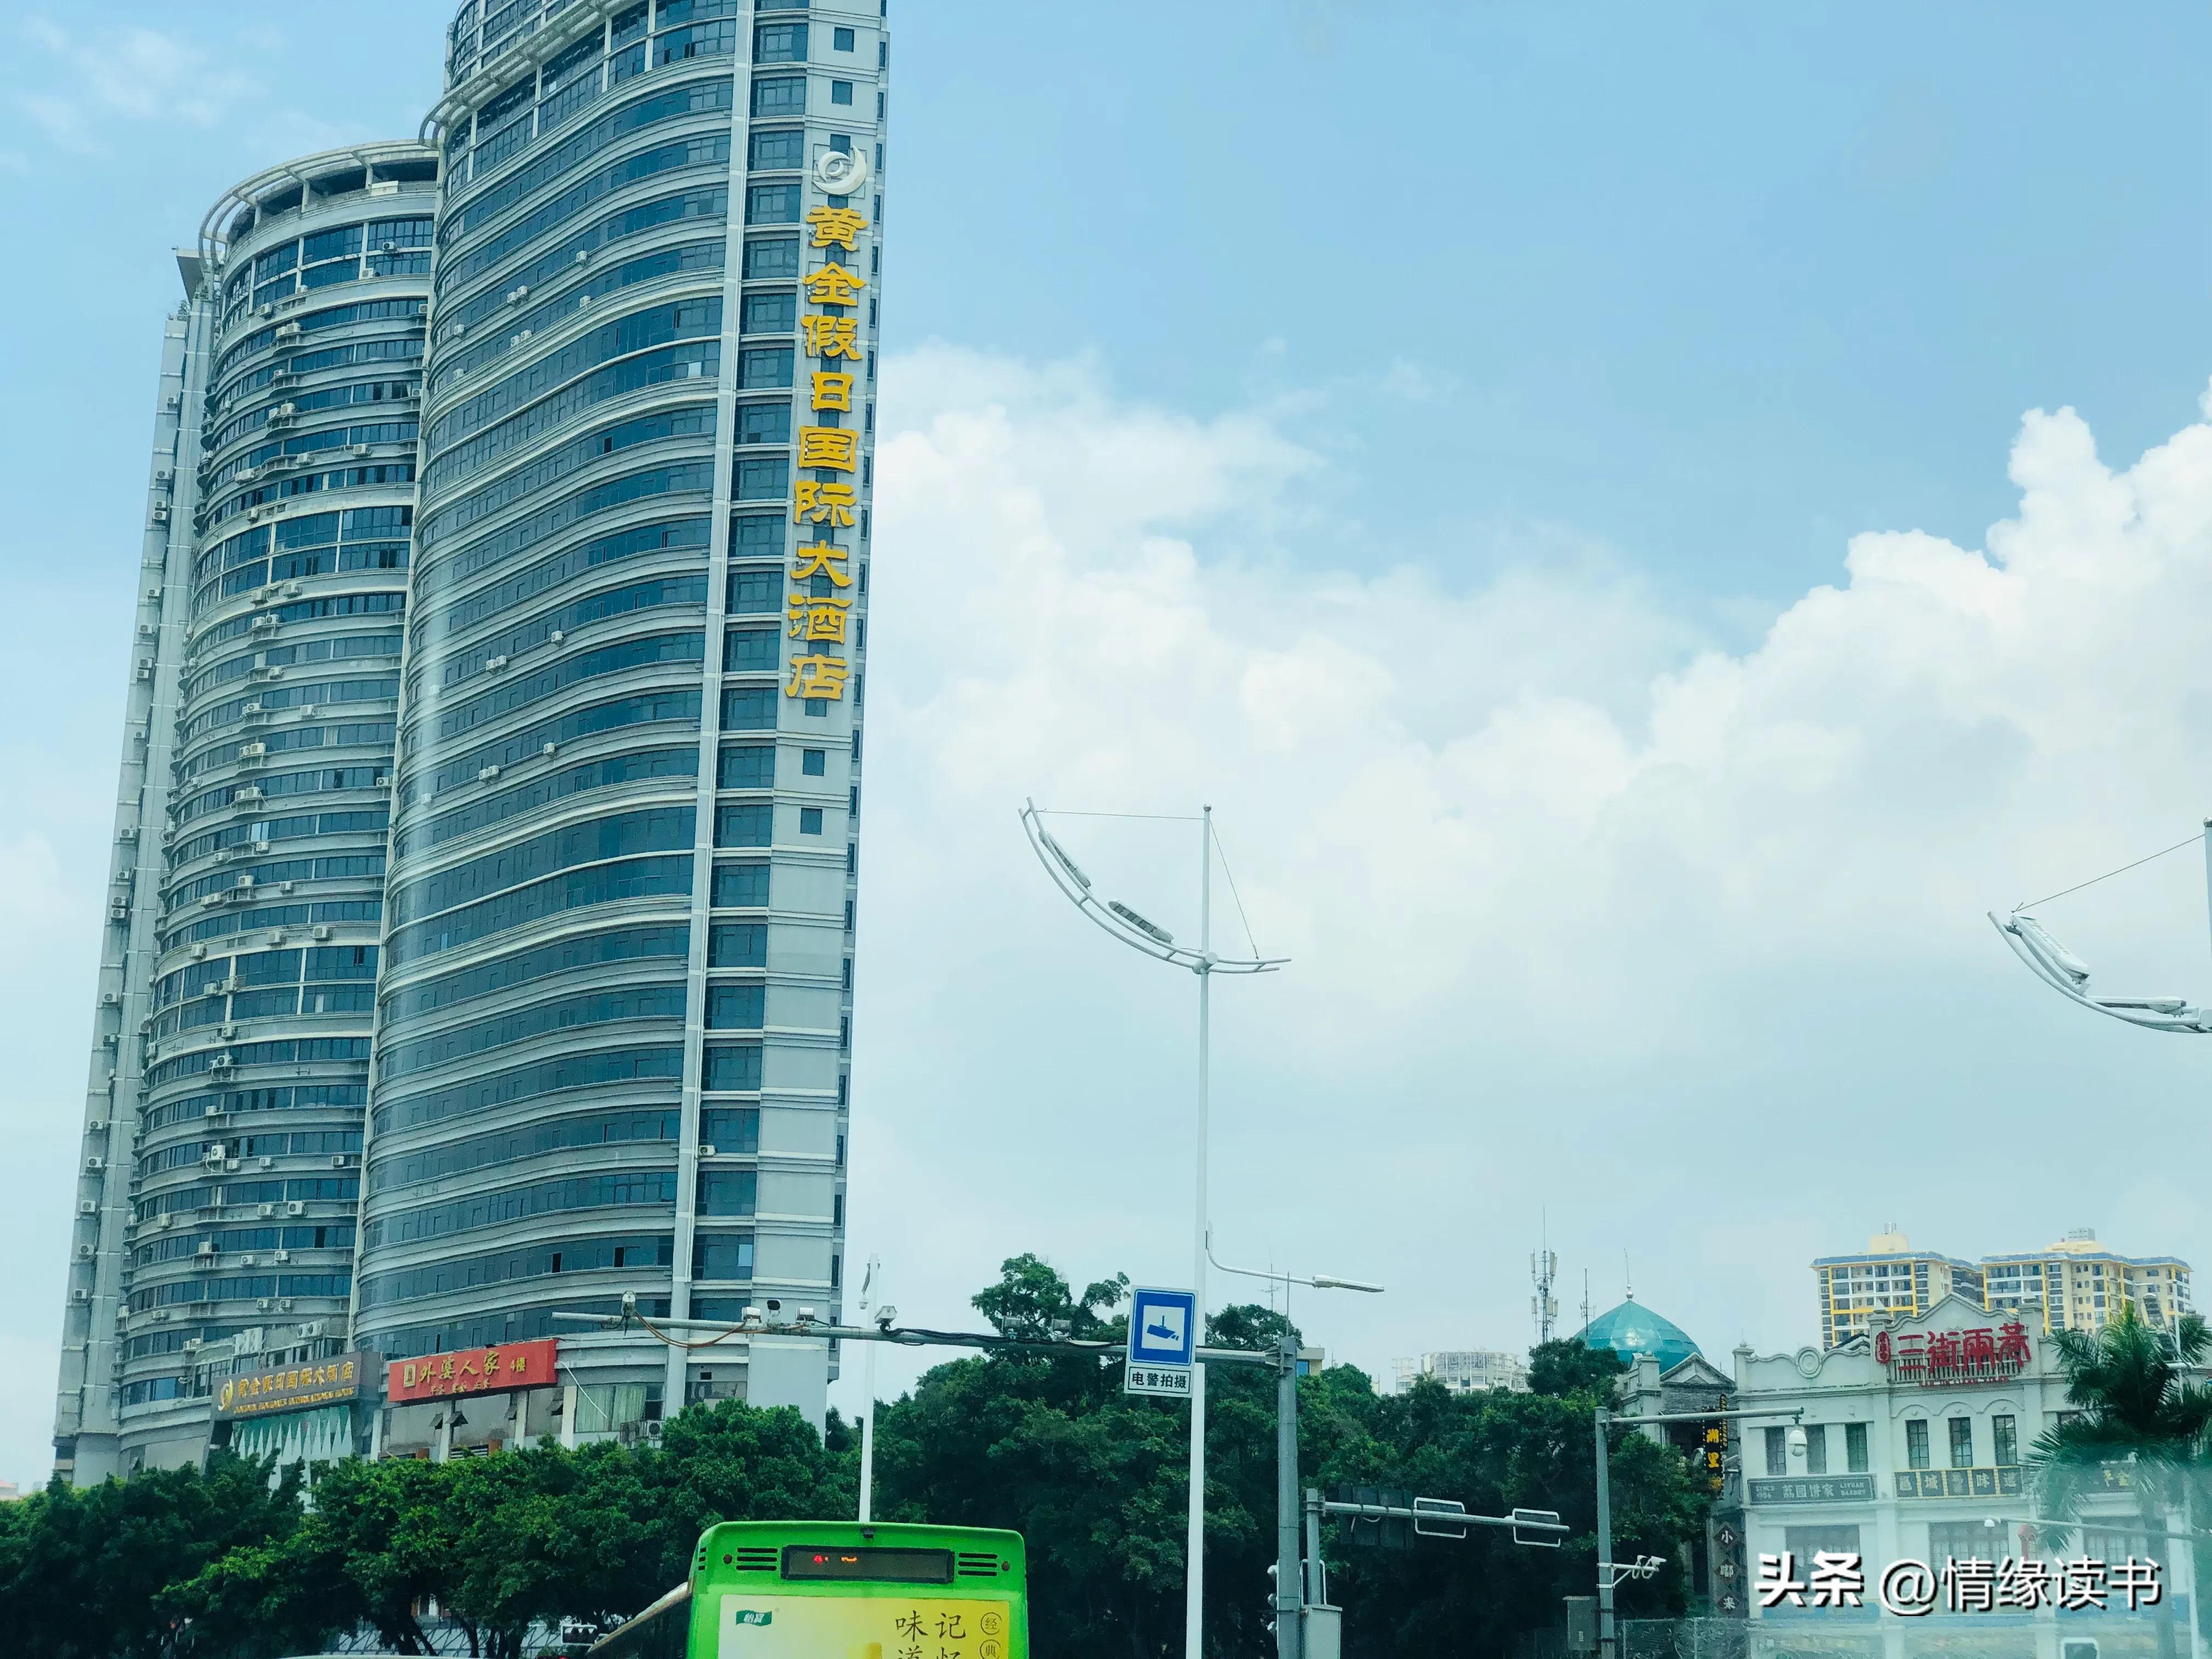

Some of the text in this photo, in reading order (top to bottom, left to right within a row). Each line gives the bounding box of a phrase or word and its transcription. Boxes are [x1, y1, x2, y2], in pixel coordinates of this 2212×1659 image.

[785, 205, 868, 701] 黄金假日国际大酒店
[419, 1351, 500, 1384] 外婆人家
[1132, 1372, 1187, 1389] 电警拍摄
